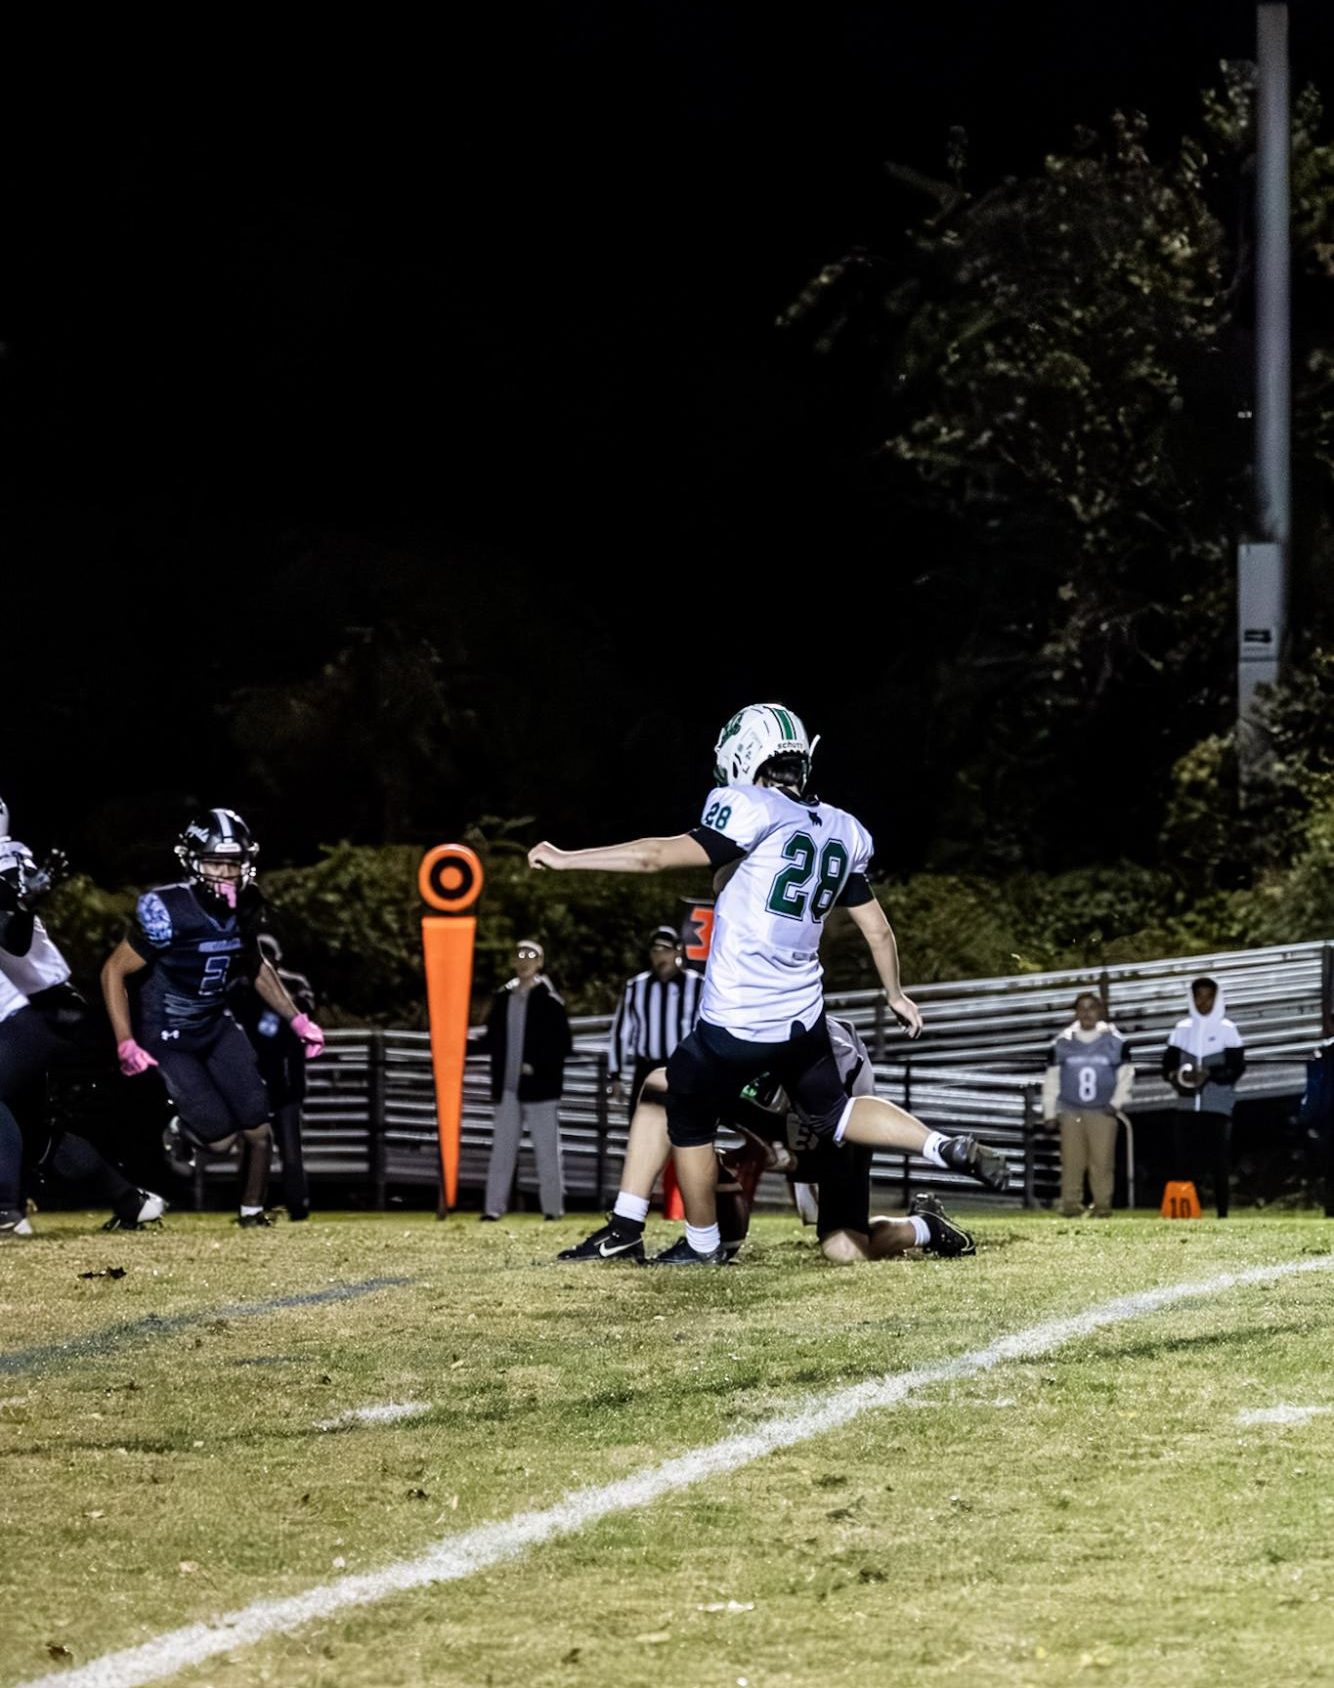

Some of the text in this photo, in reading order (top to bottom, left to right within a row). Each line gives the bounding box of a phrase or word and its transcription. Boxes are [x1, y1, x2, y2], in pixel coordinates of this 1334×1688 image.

[705, 802, 732, 831] 28
[765, 830, 848, 924] 28
[685, 906, 715, 962] 3
[198, 955, 231, 996] 5
[1079, 1066, 1097, 1102] 8
[1170, 1196, 1192, 1219] 10
